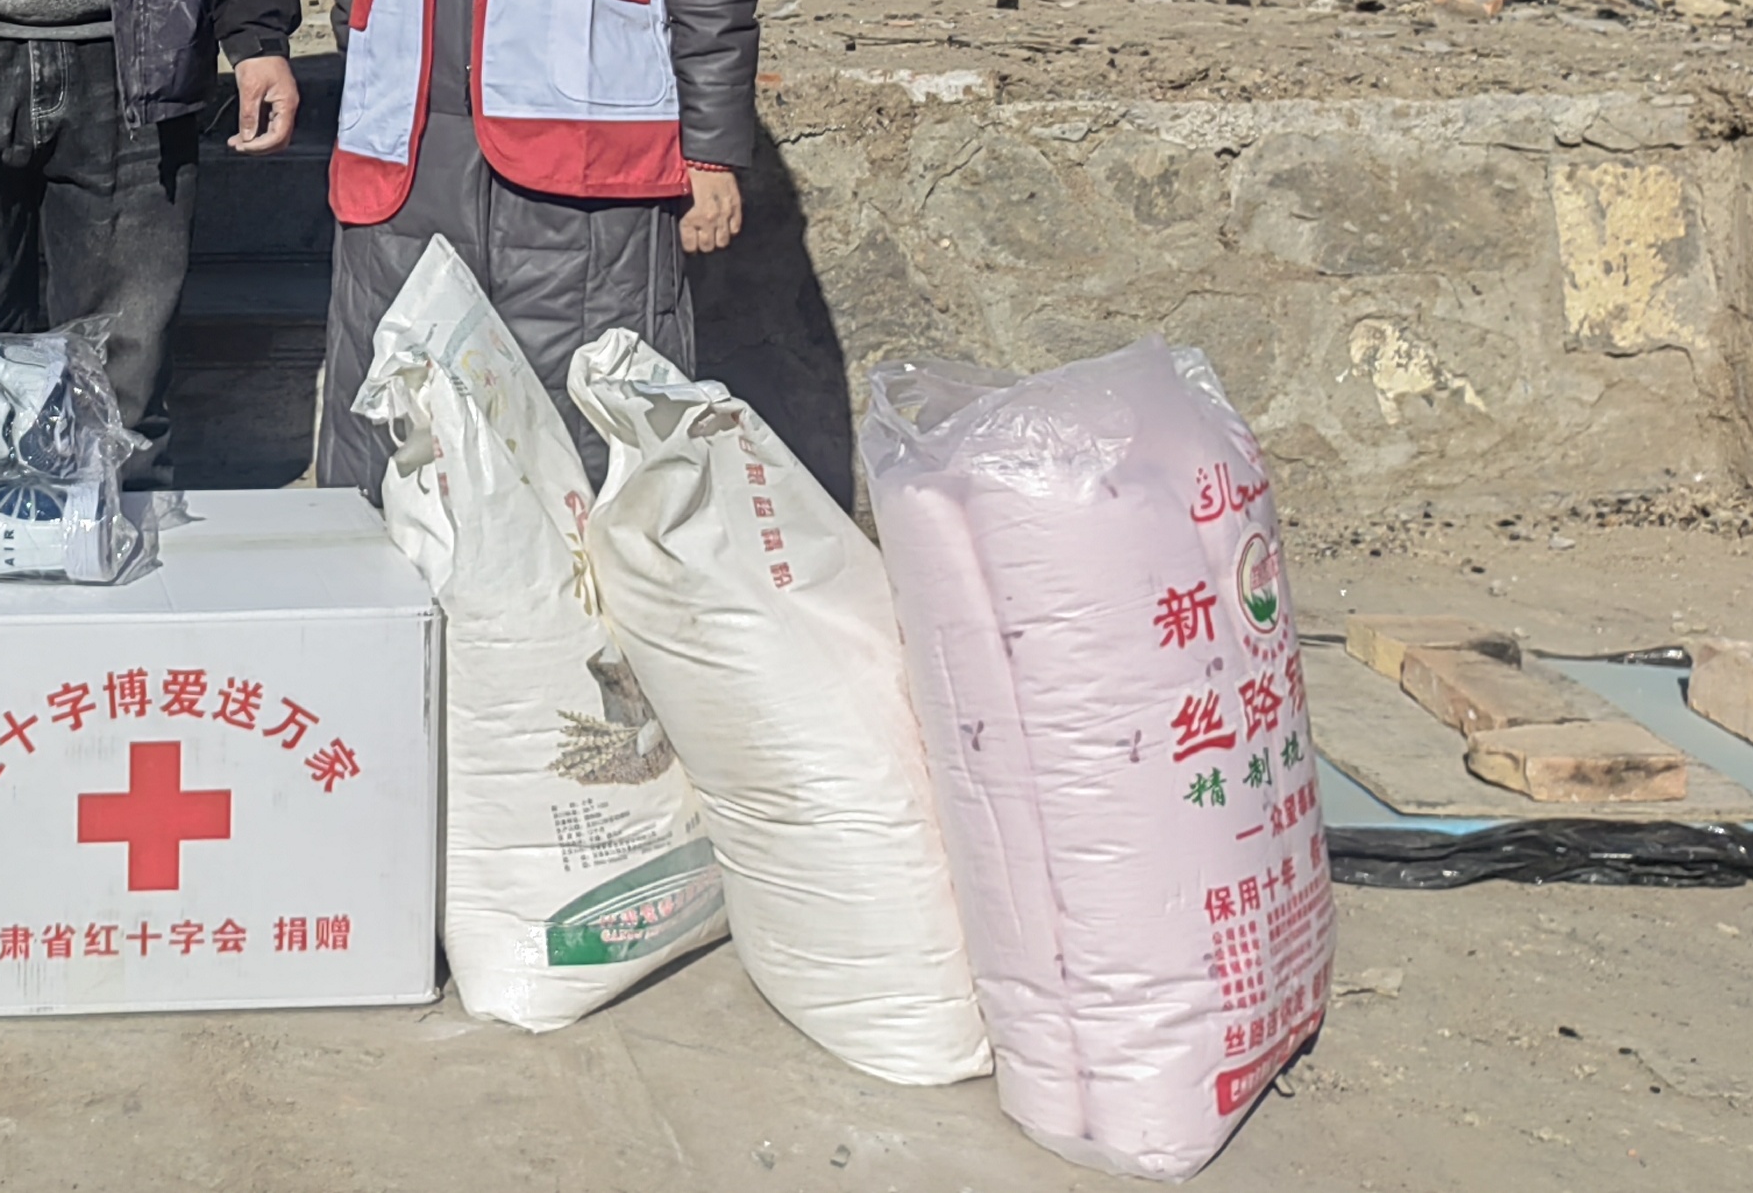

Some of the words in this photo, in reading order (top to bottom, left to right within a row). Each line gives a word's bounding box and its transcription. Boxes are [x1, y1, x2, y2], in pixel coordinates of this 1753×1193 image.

[3, 528, 15, 566] AIR
[1153, 581, 1218, 649] 新
[1204, 856, 1297, 925] 保用十年
[273, 915, 353, 953] 捐赠
